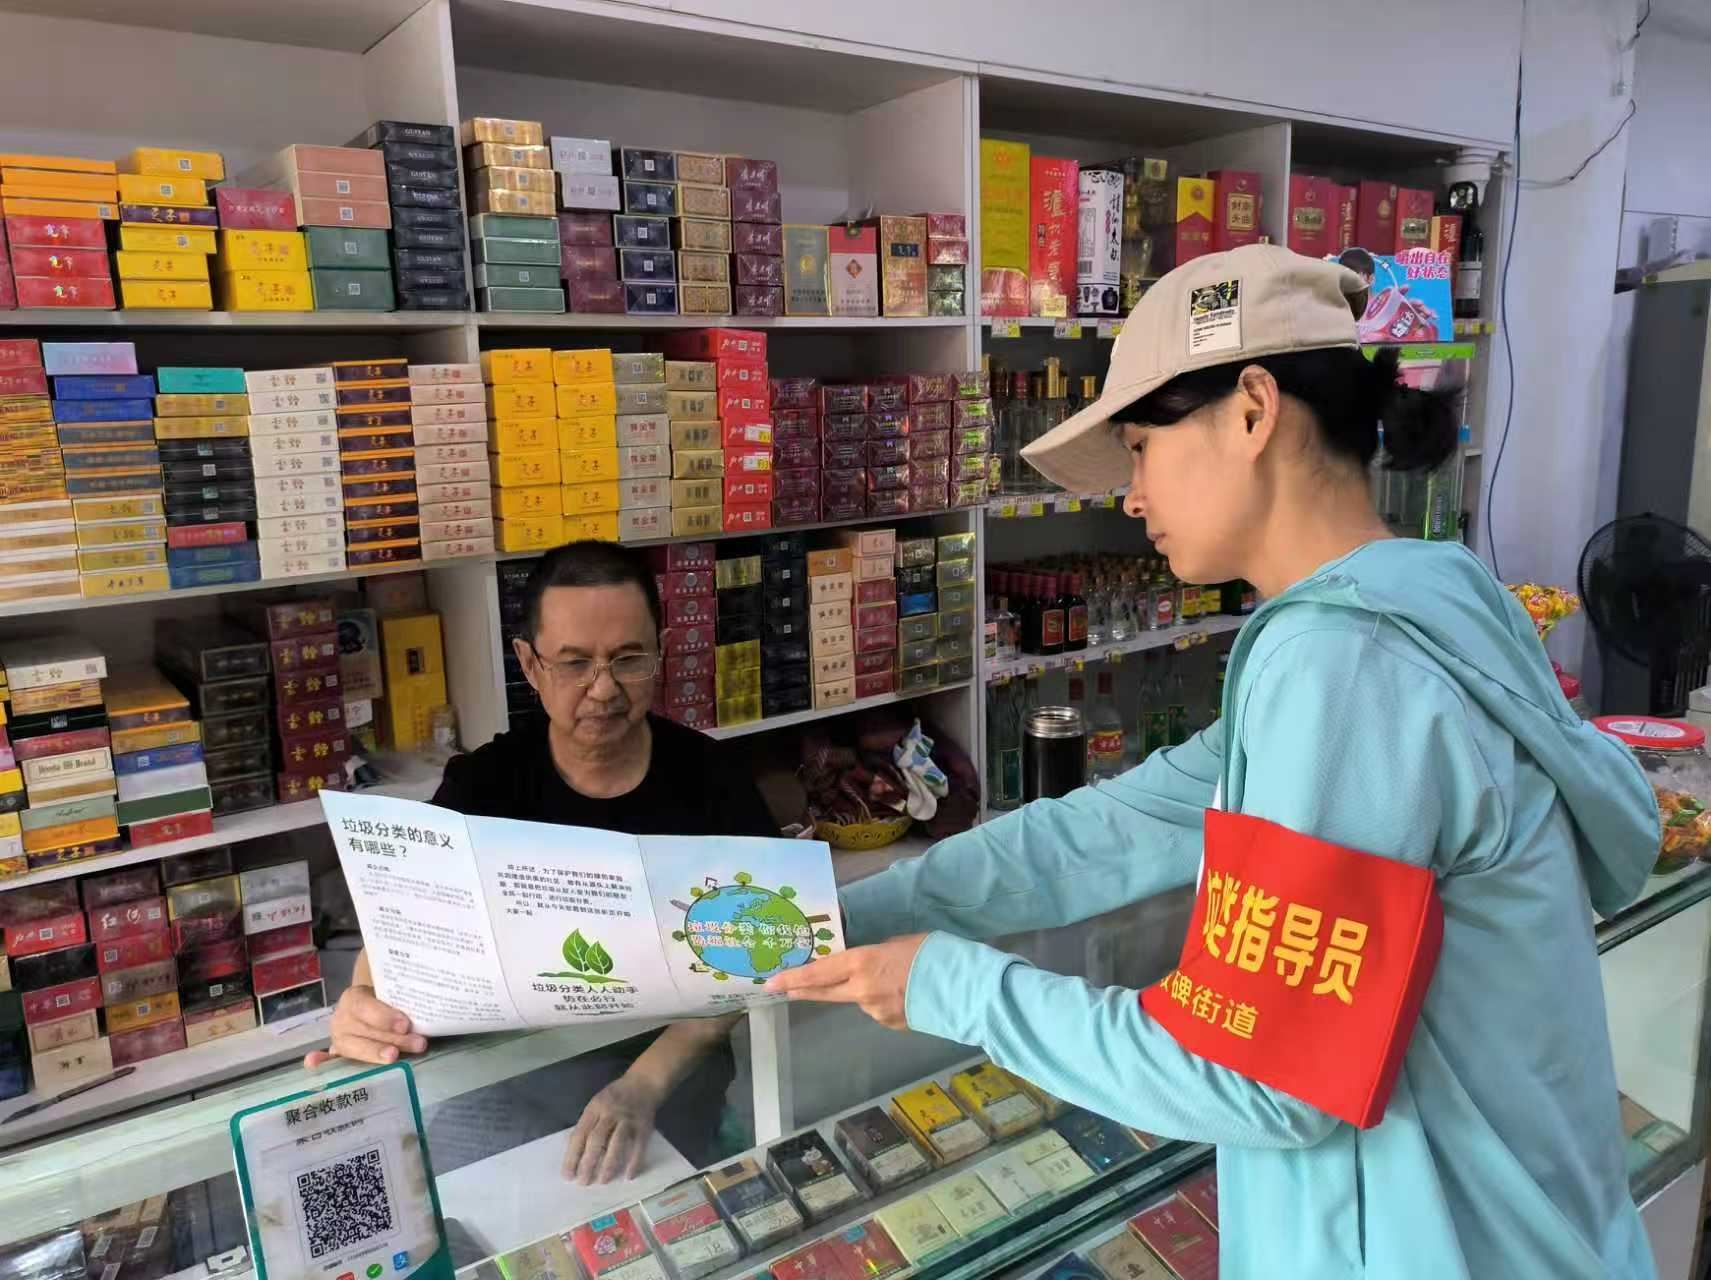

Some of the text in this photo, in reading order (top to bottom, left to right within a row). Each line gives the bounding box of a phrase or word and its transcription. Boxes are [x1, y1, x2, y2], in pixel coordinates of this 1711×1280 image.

[342, 816, 454, 850] 垃圾分类的意义
[349, 838, 408, 858] 有哪些？
[531, 982, 639, 994] 垃圾分类人人动手
[284, 1087, 369, 1127] 聚合收款码
